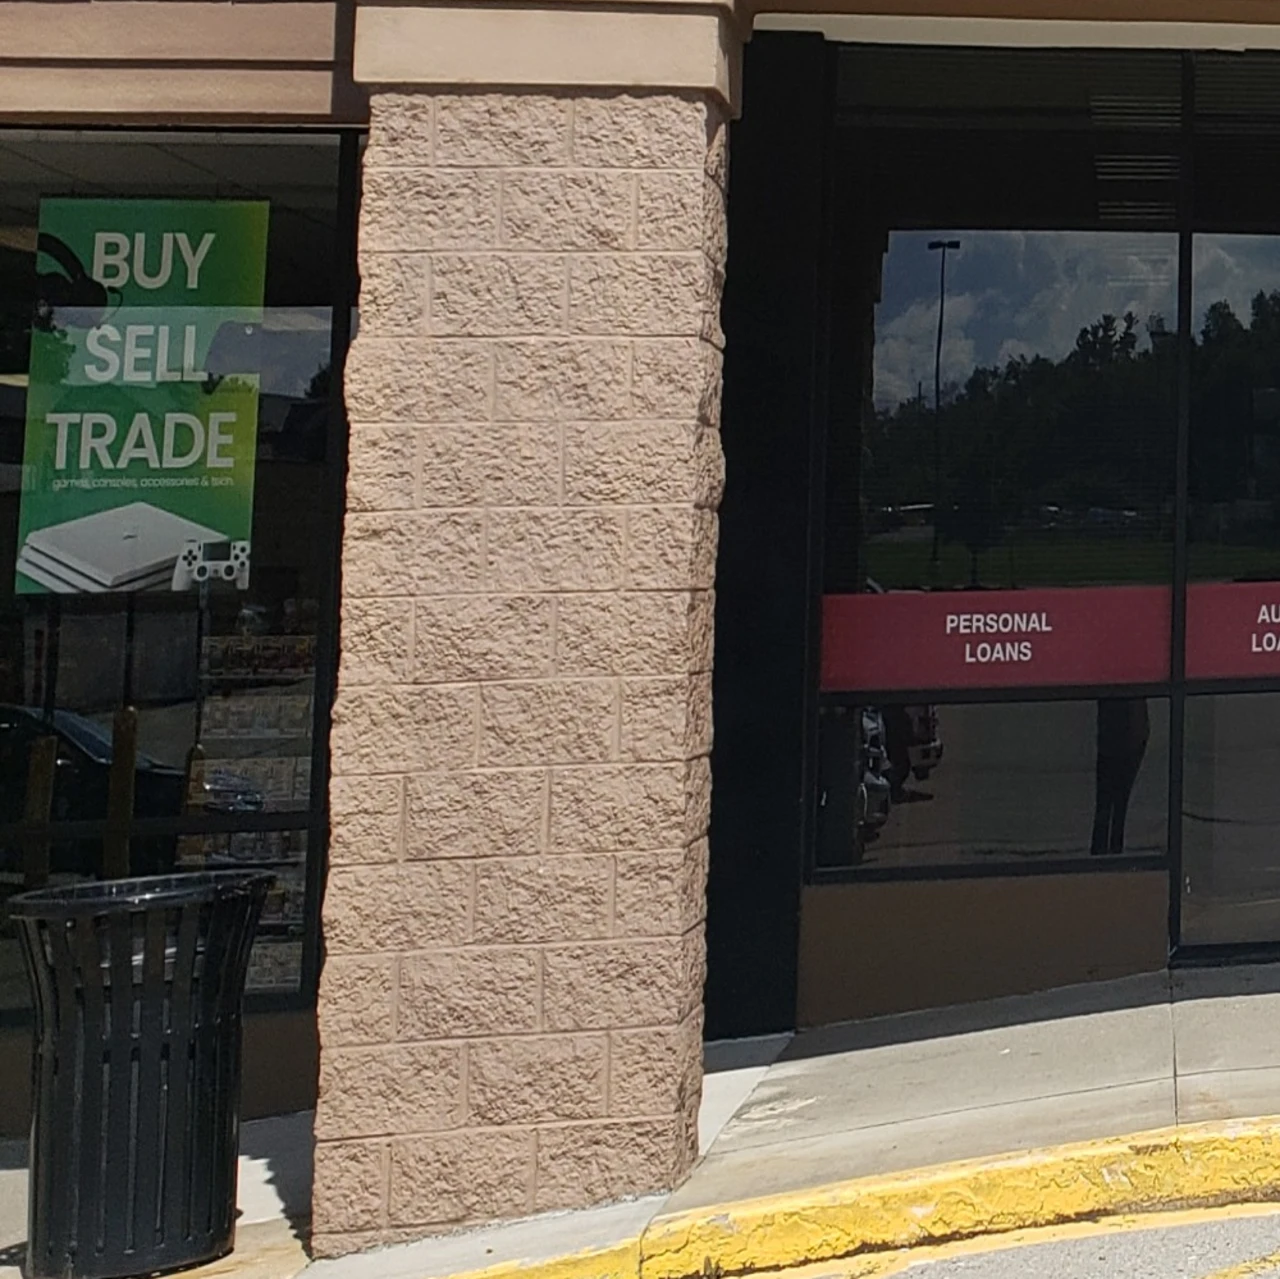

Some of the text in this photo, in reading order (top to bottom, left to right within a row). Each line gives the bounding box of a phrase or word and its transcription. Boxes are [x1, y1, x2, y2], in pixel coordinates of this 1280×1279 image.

[92, 232, 216, 290] BUY
[84, 324, 208, 382] SELL
[46, 411, 237, 470] TRADE
[946, 612, 1052, 634] PERSONAL
[965, 641, 1032, 663] LOANS
